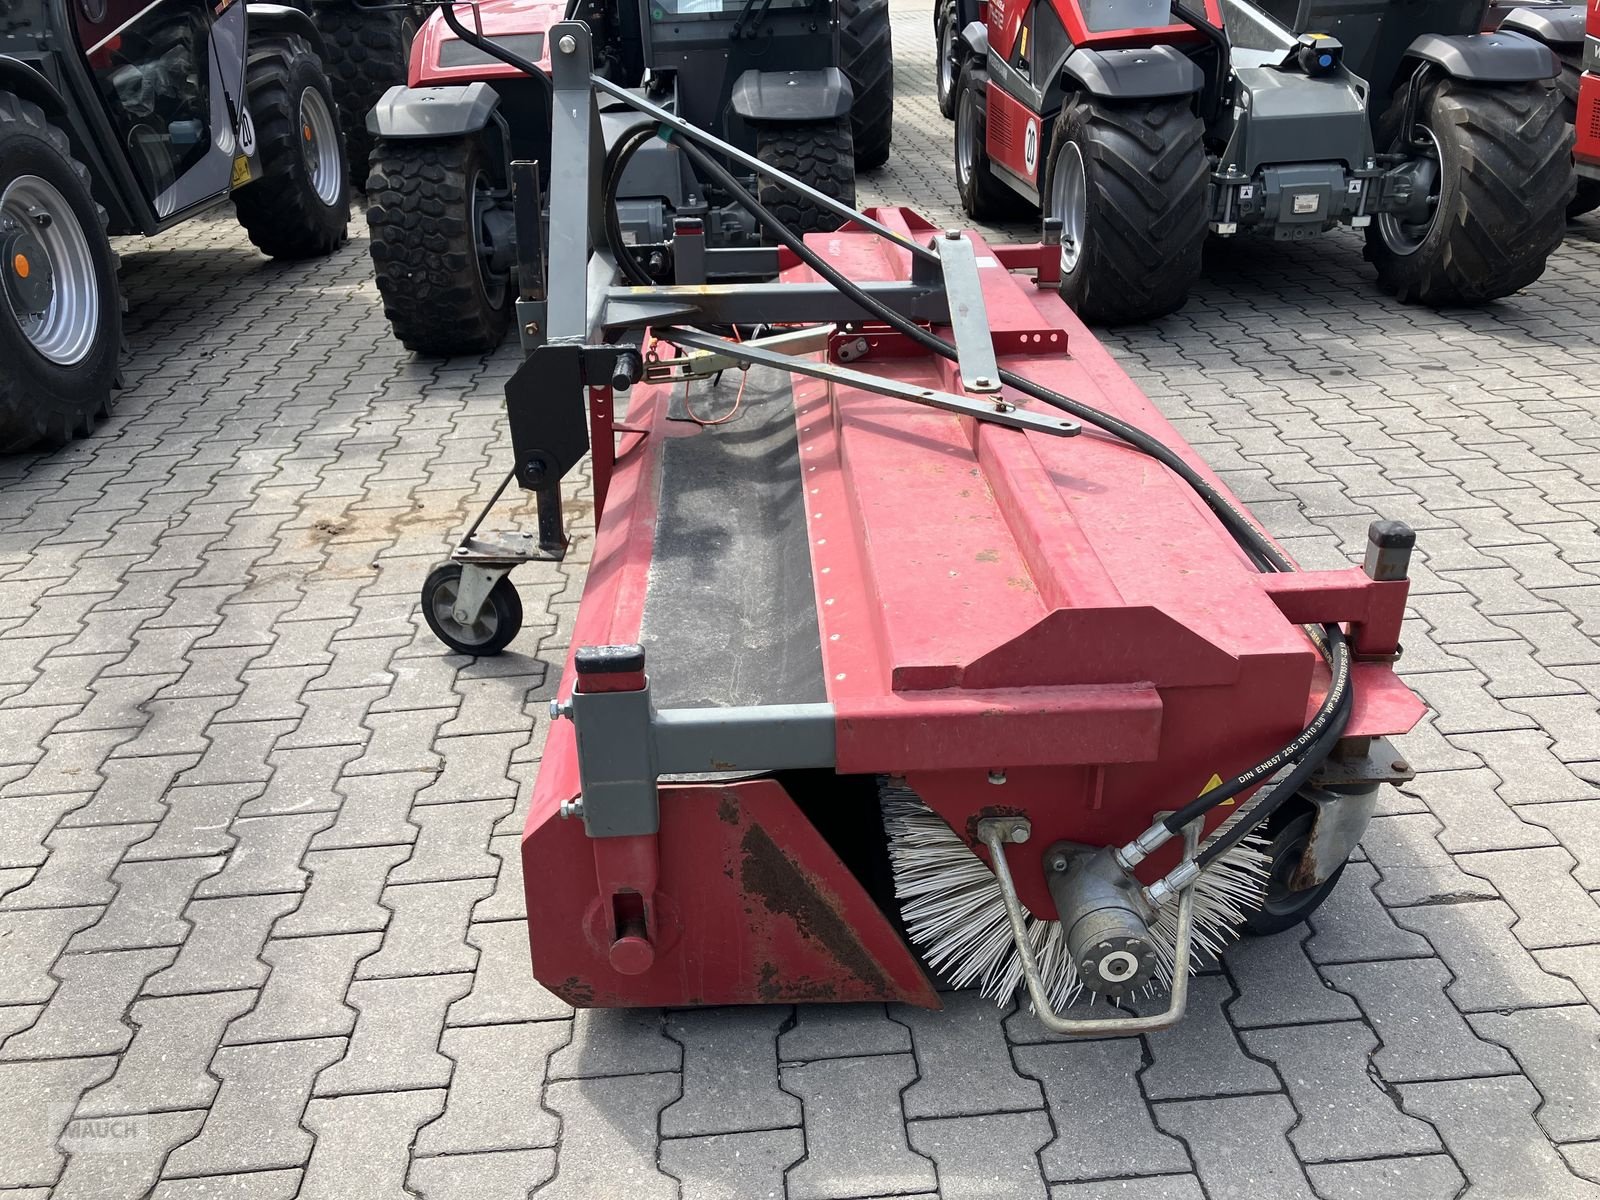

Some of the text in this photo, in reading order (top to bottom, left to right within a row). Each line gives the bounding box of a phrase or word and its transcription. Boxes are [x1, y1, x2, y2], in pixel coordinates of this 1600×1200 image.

[242, 113, 253, 147] 20
[1027, 128, 1036, 166] 20
[1238, 771, 1255, 783] DIN
[1255, 754, 1282, 774] EN857
[1282, 742, 1299, 757] 2SC
[1298, 726, 1317, 744] DN10
[1324, 702, 1336, 714] WP
